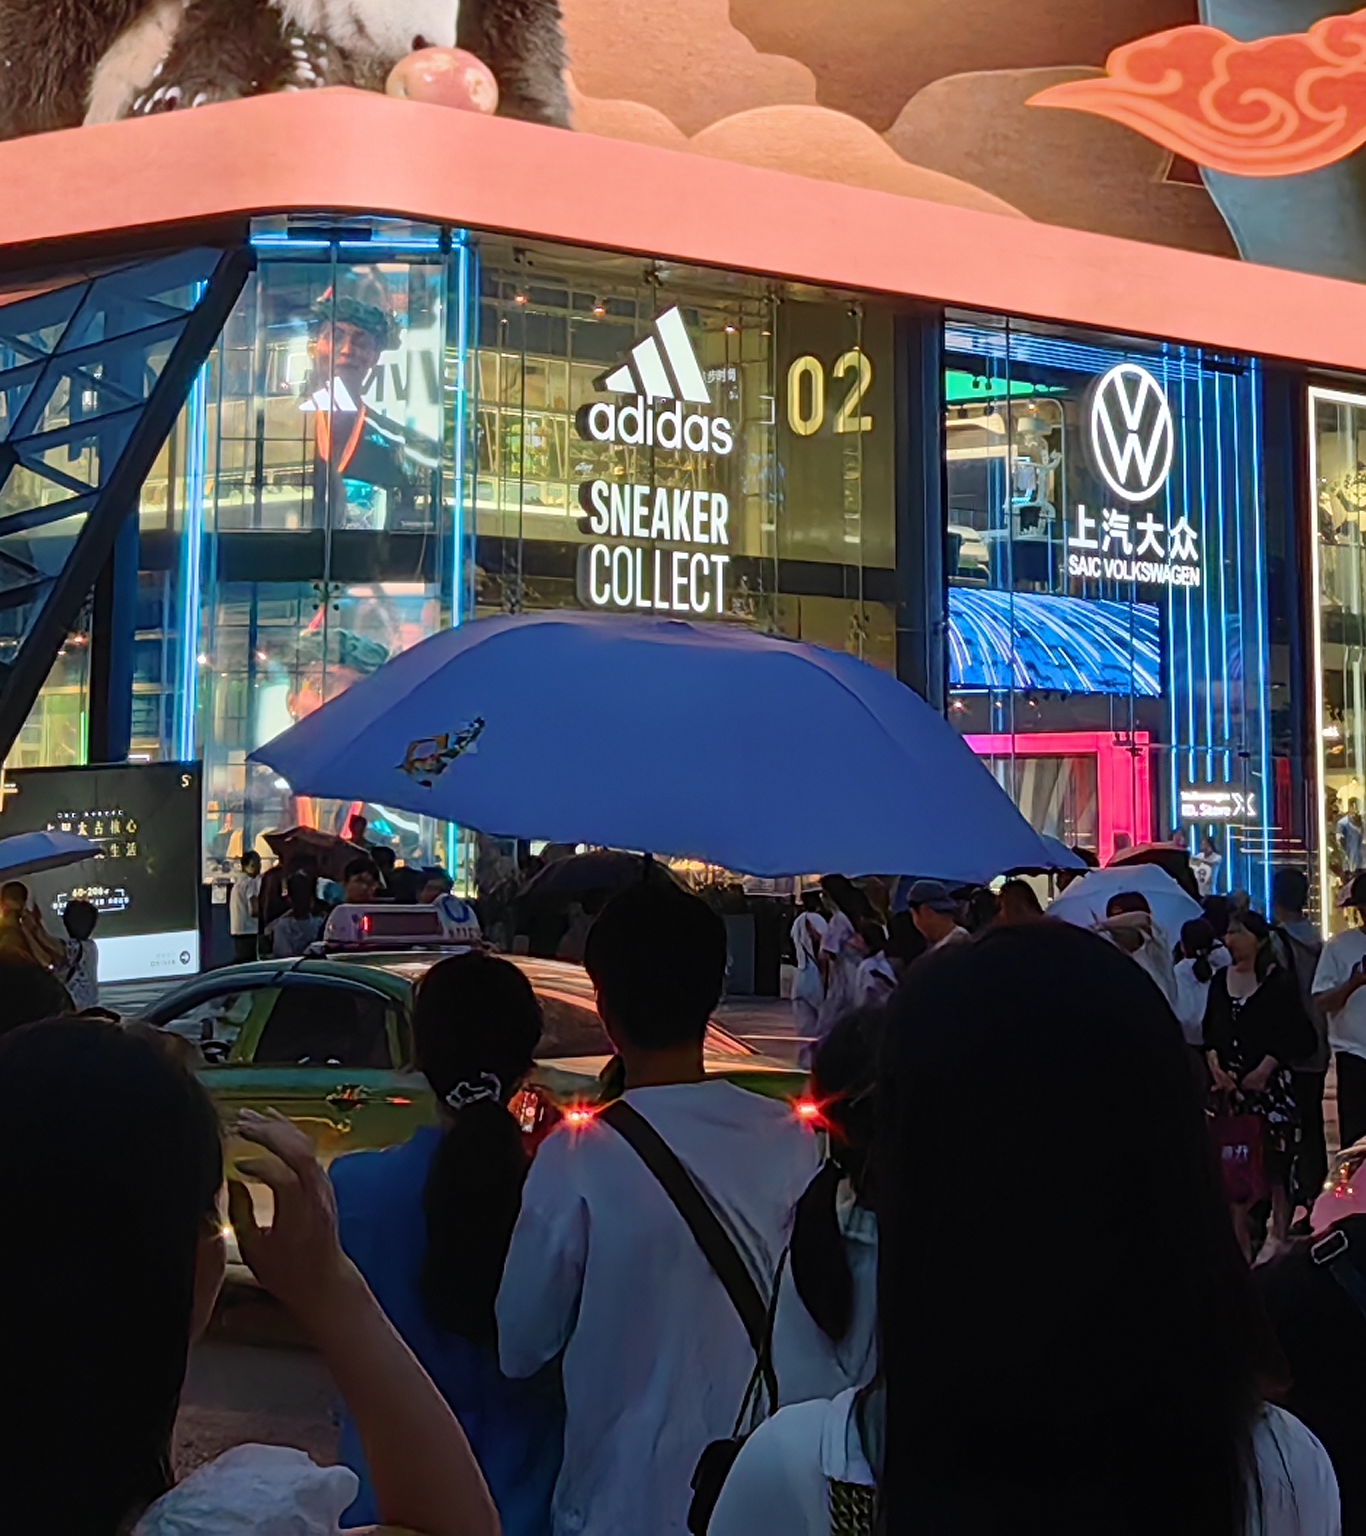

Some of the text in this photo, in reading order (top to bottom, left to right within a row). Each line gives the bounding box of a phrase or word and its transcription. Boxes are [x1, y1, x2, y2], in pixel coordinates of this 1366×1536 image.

[787, 351, 873, 436] 02
[589, 394, 733, 455] adidas
[590, 479, 730, 545] SNEAKER
[1067, 504, 1199, 561] 上汽大众
[589, 544, 731, 614] COLLECT
[1068, 554, 1200, 586] SAIC VOLKSWAGEN
[94, 842, 137, 860] 生活
